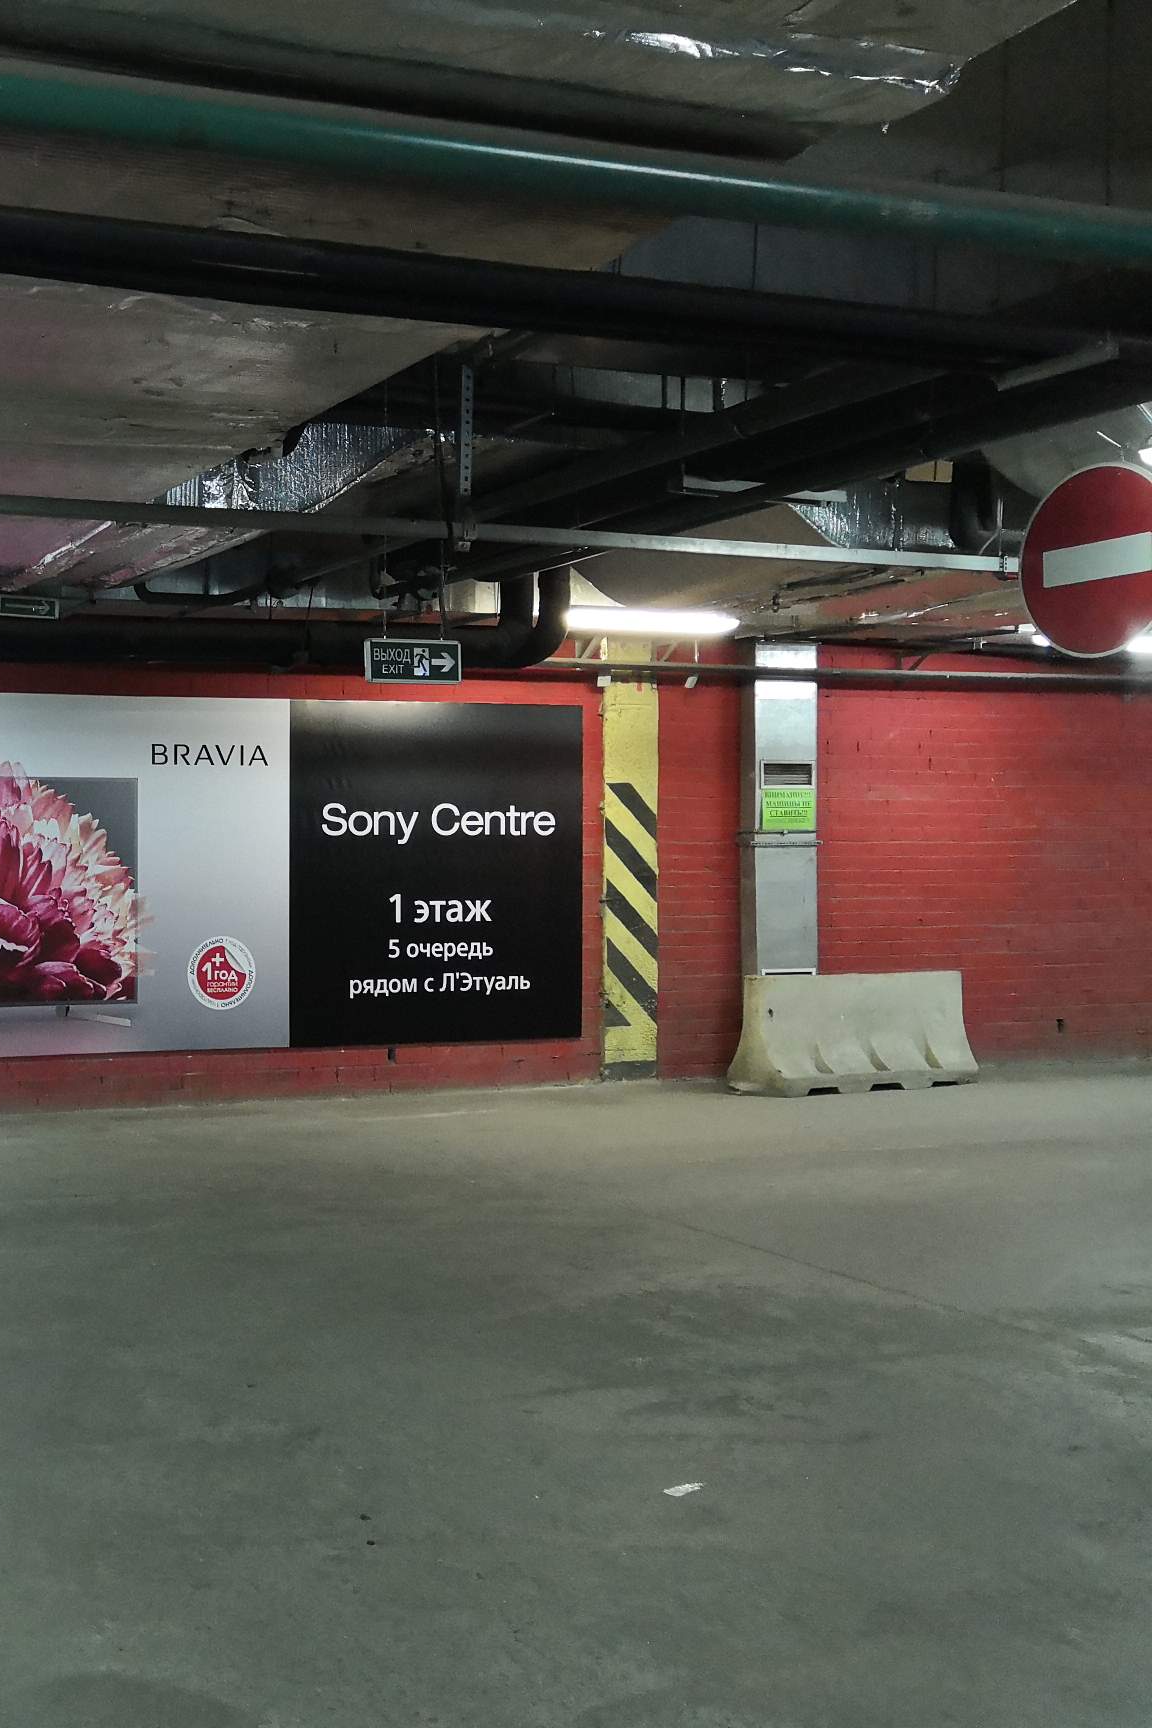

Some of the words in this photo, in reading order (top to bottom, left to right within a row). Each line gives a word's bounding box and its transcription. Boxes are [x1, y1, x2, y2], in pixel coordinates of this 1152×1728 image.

[373, 648, 411, 664] ВЫХОД
[382, 664, 405, 674] EXIT
[151, 743, 269, 766] BRAVIA
[321, 802, 419, 844] Sony
[431, 802, 556, 836] Centre
[389, 894, 402, 923] 1
[413, 899, 493, 923] этаж
[388, 939, 400, 959] 5
[406, 940, 494, 961] очередь
[349, 977, 417, 999] рядом
[424, 978, 434, 993] с
[440, 972, 531, 996] Л'Этуаль
